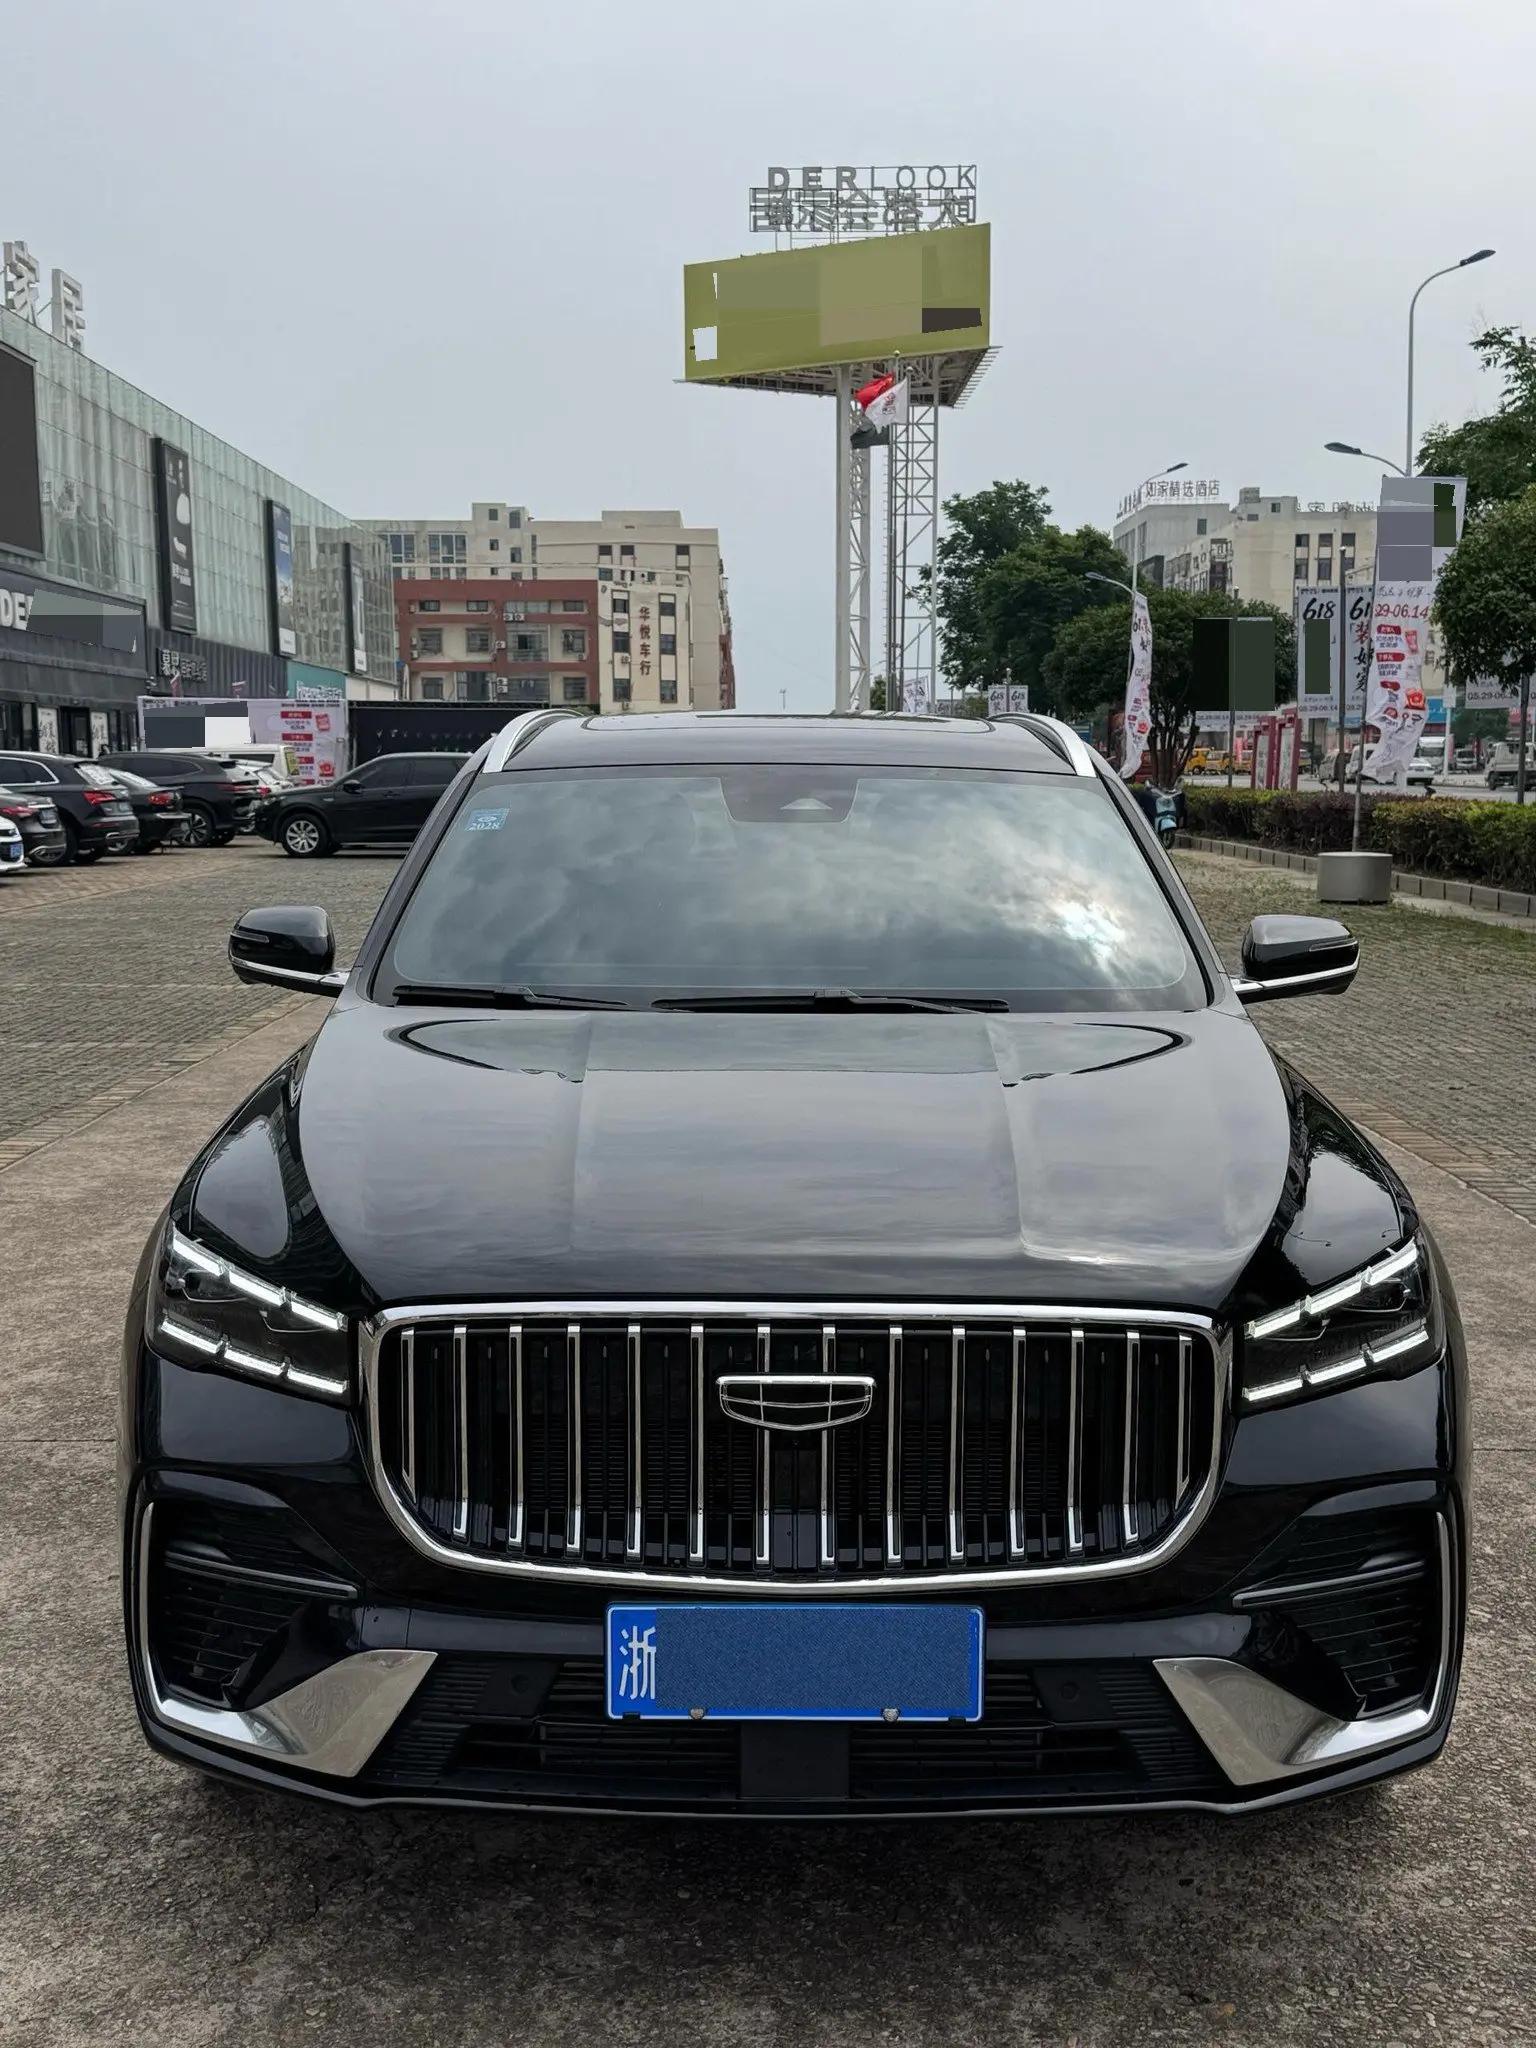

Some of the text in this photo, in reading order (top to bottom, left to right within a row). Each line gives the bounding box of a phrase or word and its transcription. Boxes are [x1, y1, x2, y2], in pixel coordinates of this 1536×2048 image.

[1302, 596, 1336, 620] 618
[1349, 596, 1371, 620] 61
[638, 606, 651, 676] 华悦车行
